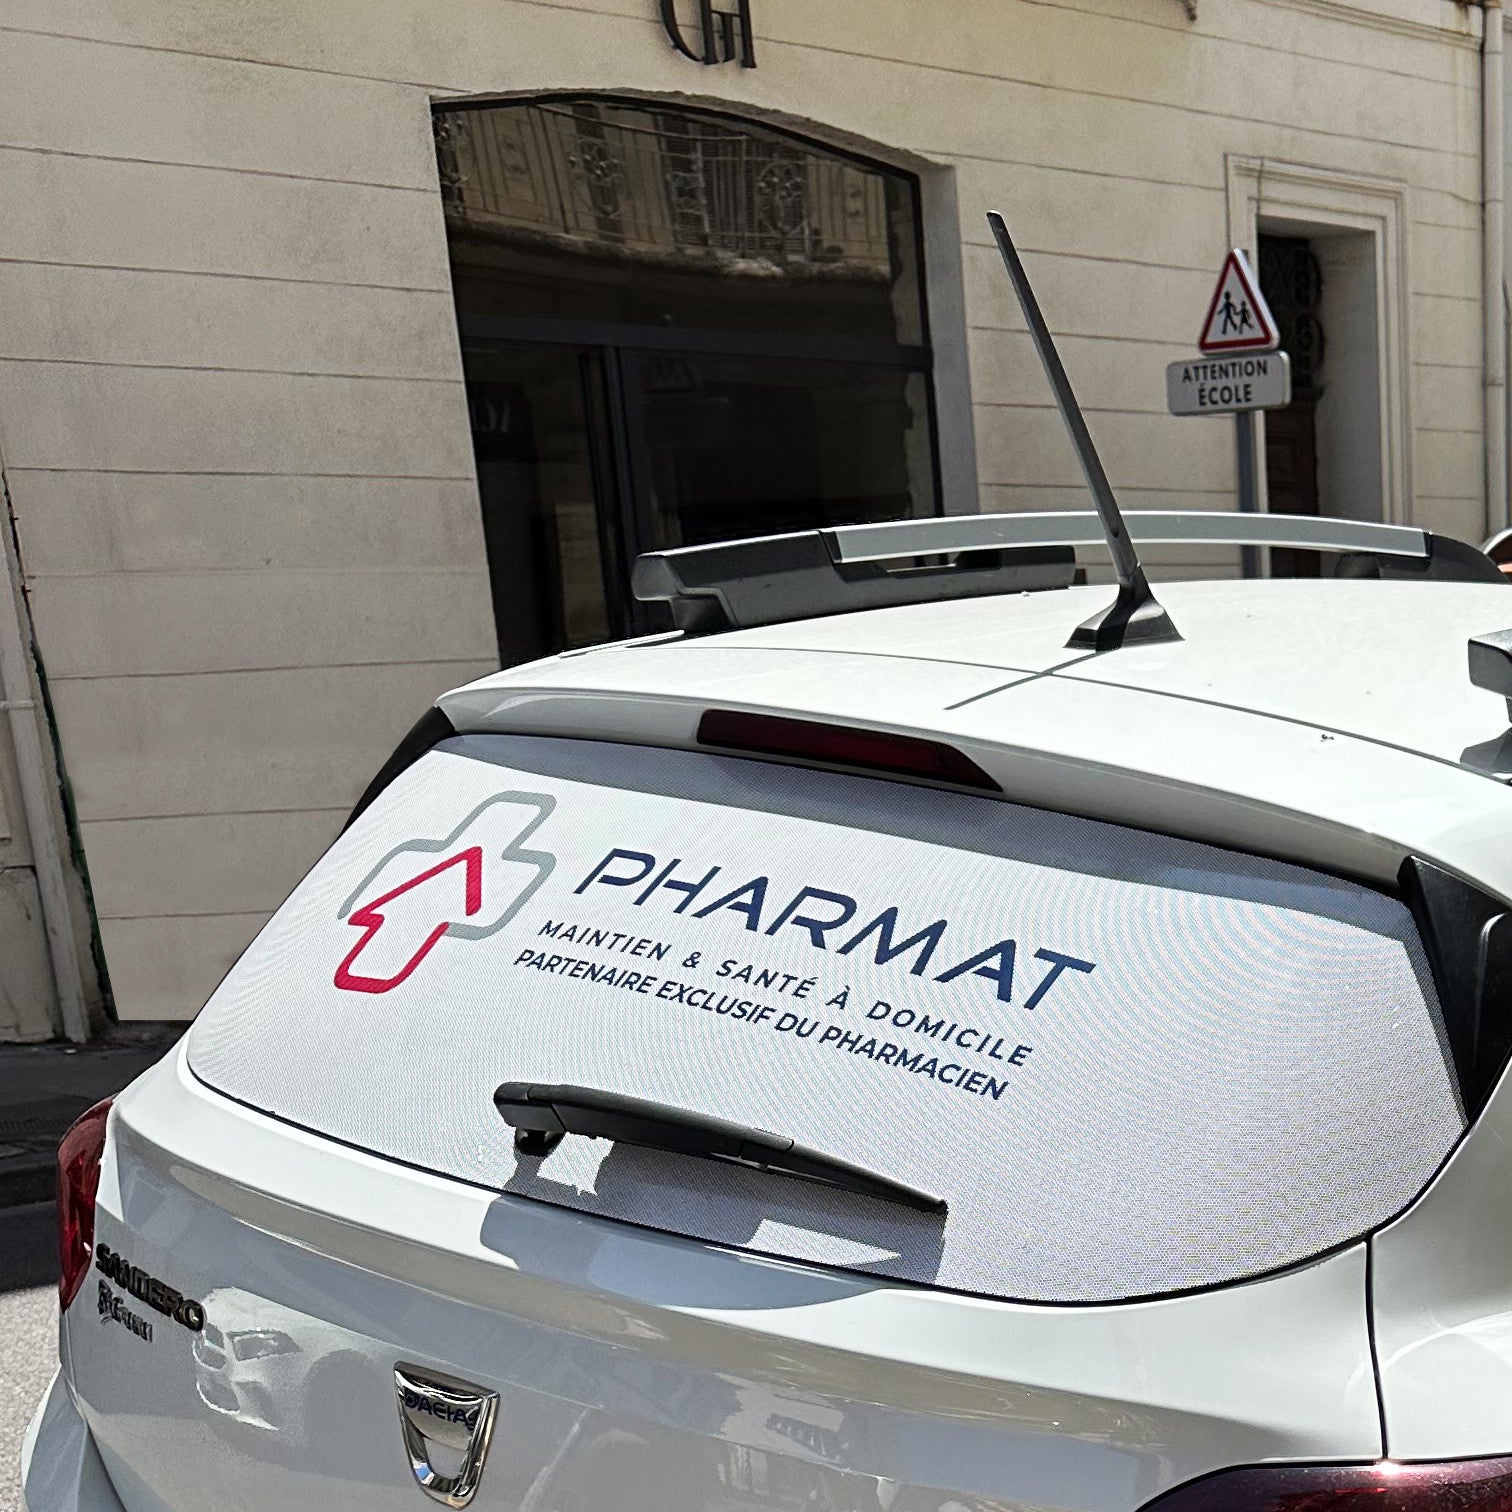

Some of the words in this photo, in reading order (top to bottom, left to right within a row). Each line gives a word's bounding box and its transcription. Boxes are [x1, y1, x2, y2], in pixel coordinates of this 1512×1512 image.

[1181, 359, 1269, 383] ATTENTION
[1199, 383, 1253, 407] ÉCOLE
[573, 848, 1097, 1011] PHARMAT
[513, 948, 658, 995] PARTENAIRE
[655, 980, 777, 1025] EXCLUSIF
[774, 1012, 820, 1038] DU
[818, 1025, 1009, 1101] PHARMACIEN
[537, 919, 672, 961] MAINTIEN
[682, 951, 702, 969] &
[716, 959, 818, 999] SANTÉ
[825, 985, 850, 1010] À
[866, 1000, 1034, 1067] DOMICILE
[96, 1242, 207, 1333] SANDERO
